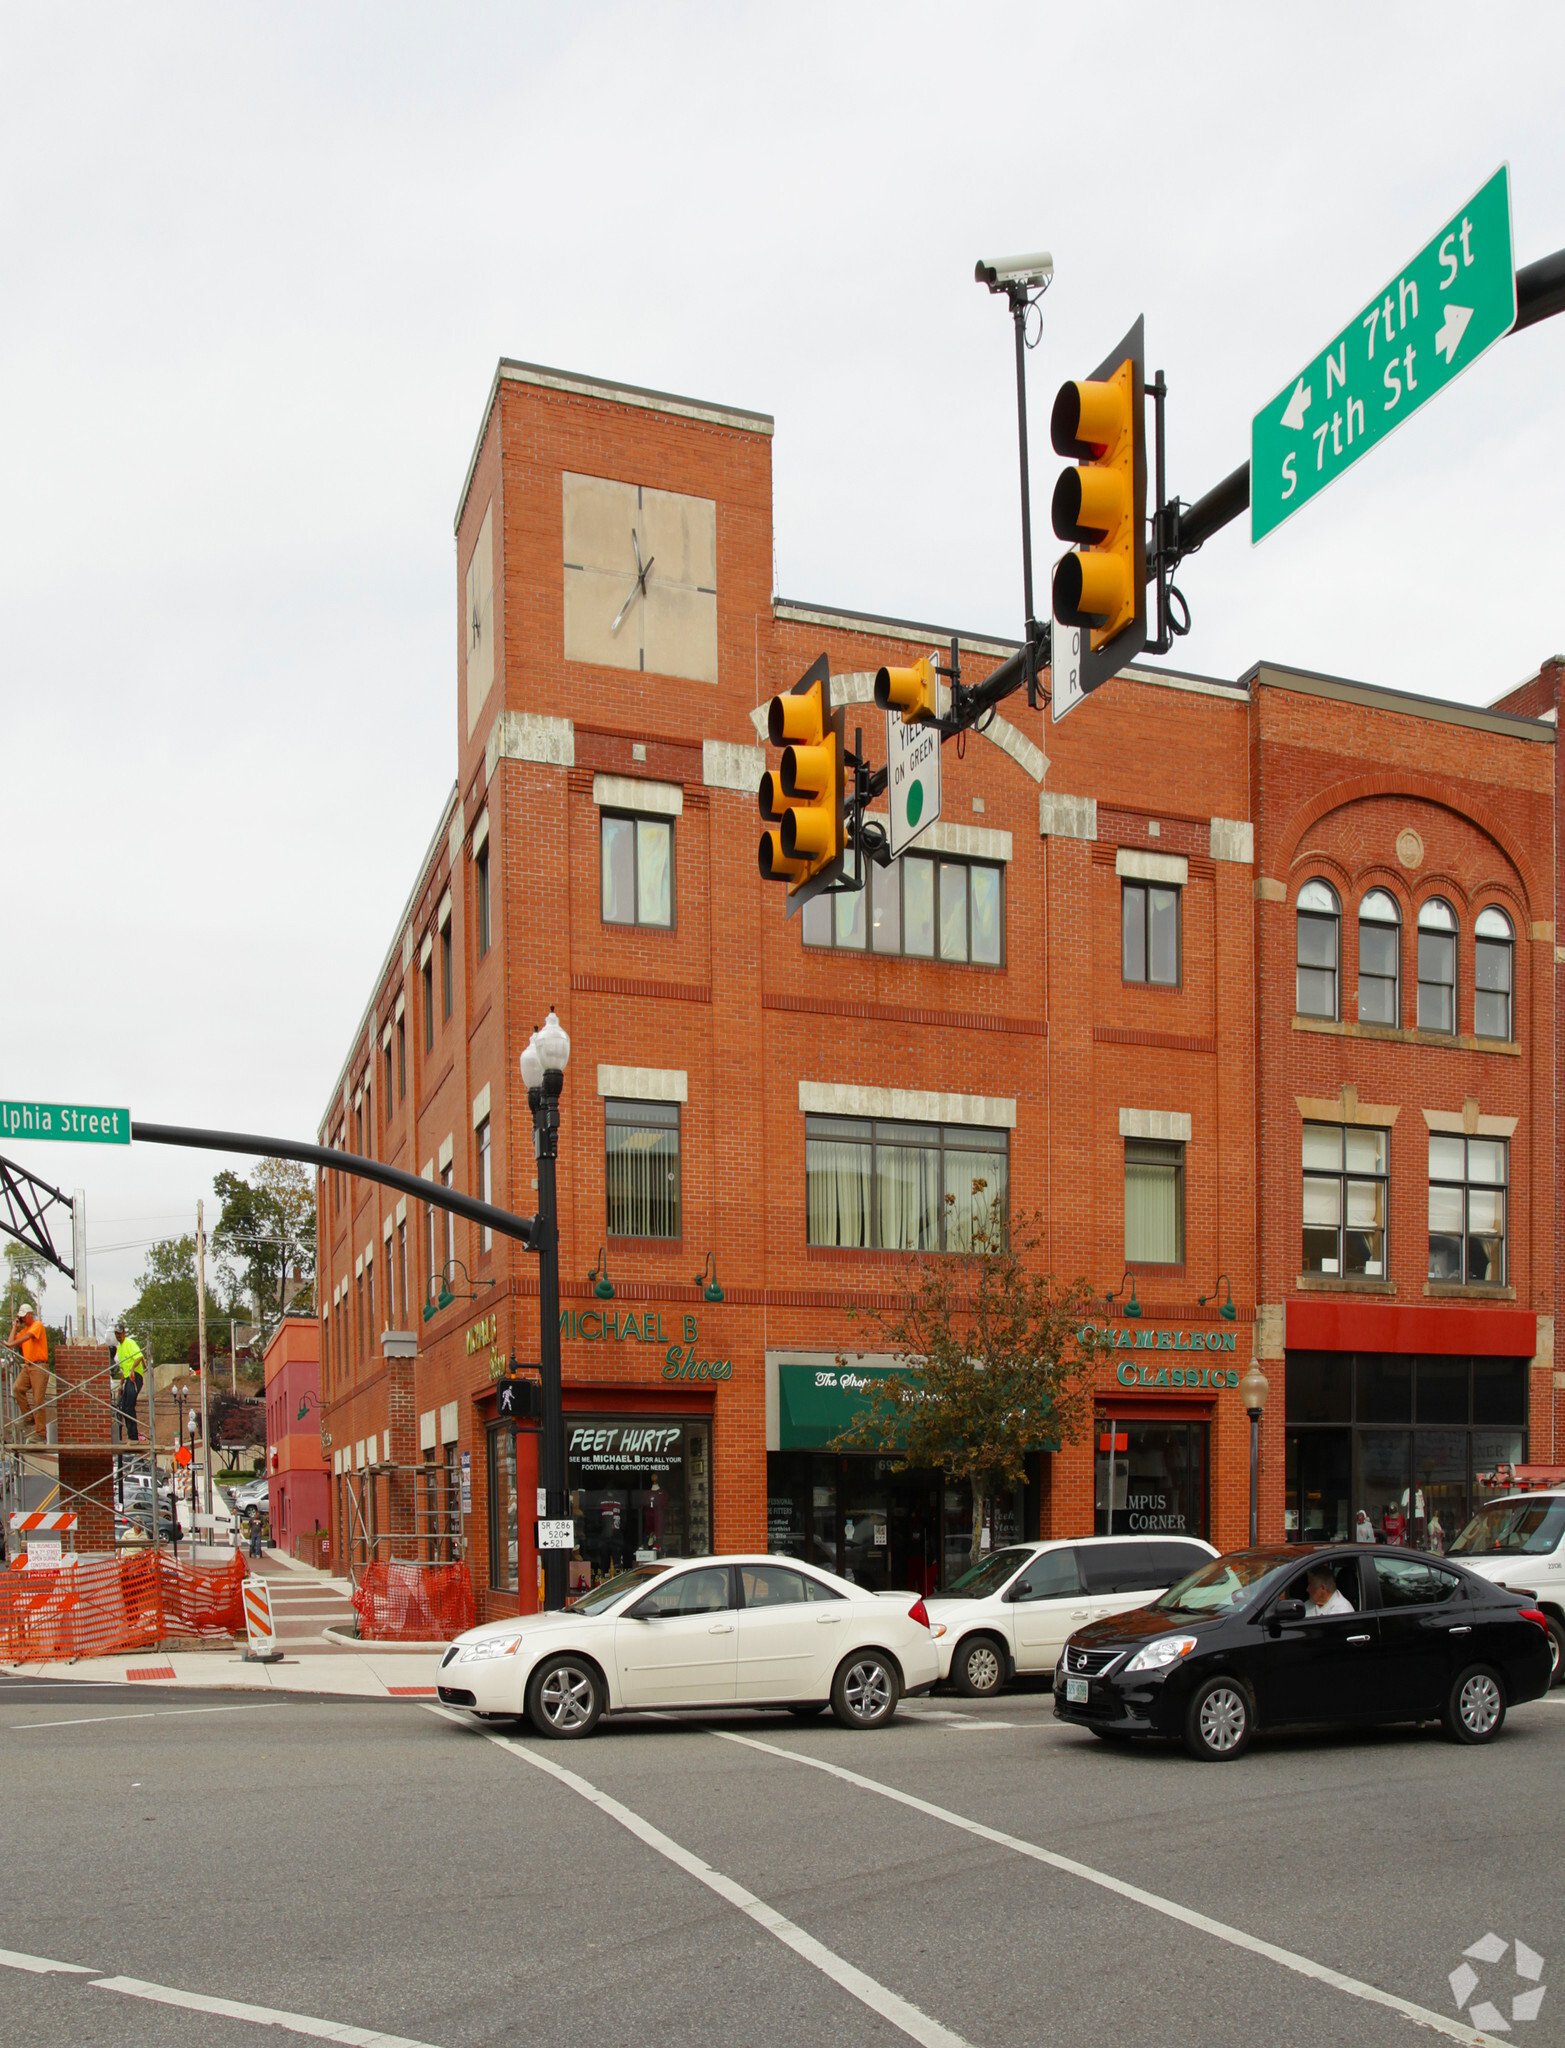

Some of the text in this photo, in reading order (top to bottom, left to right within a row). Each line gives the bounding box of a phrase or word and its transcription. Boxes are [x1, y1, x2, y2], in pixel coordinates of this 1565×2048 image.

[1326, 216, 1475, 399] N 7th St
[1281, 343, 1418, 500] S 7th St
[895, 733, 934, 785] ON GREEN
[2, 1104, 119, 1135] lphia Street
[683, 1314, 699, 1343] B
[661, 1345, 733, 1380] Shoes
[815, 1371, 838, 1387] The
[569, 1428, 681, 1453] FEET HURT?
[581, 1456, 592, 1464] ME,
[593, 1455, 632, 1463] MICHAEL
[634, 1455, 641, 1463] B
[541, 1522, 570, 1530] SR 286
[1129, 1512, 1186, 1530] CORNER
[548, 1530, 564, 1538] 520
[550, 1540, 562, 1548] 521
